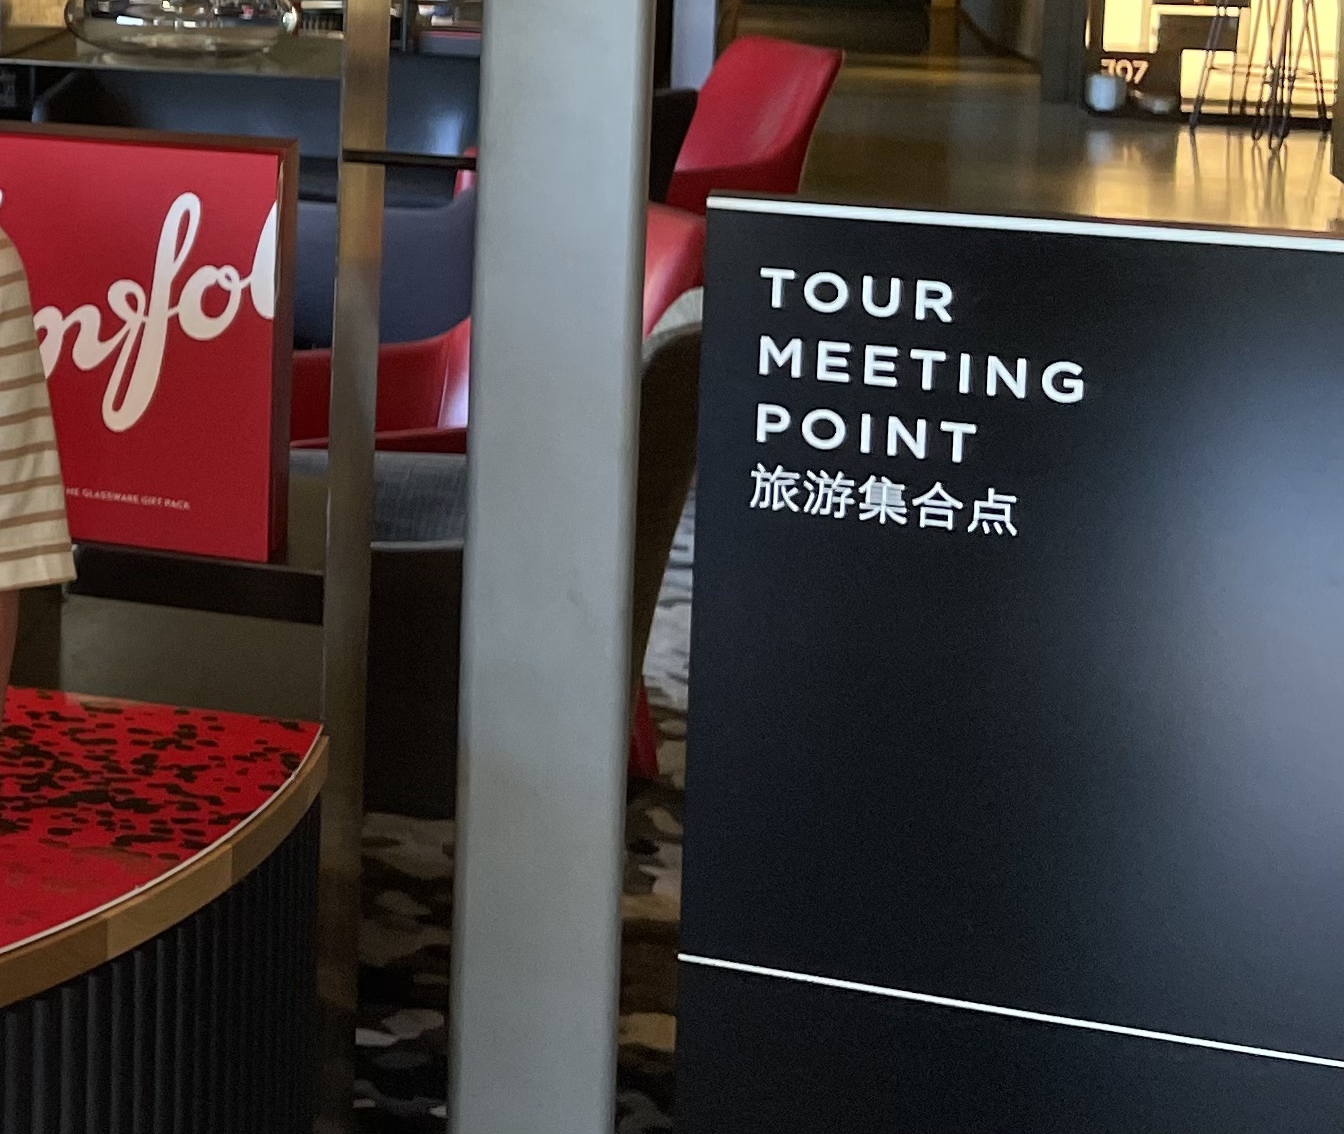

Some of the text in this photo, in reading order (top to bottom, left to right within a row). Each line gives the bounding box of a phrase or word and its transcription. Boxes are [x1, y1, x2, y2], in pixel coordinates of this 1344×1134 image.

[1100, 58, 1149, 85] 707
[759, 266, 955, 324] TOUR
[758, 335, 1086, 405] MEETING
[755, 402, 978, 465] POINT
[65, 487, 80, 497] HE
[140, 495, 163, 507] GIFT
[749, 463, 1018, 537] 旅游集合点
